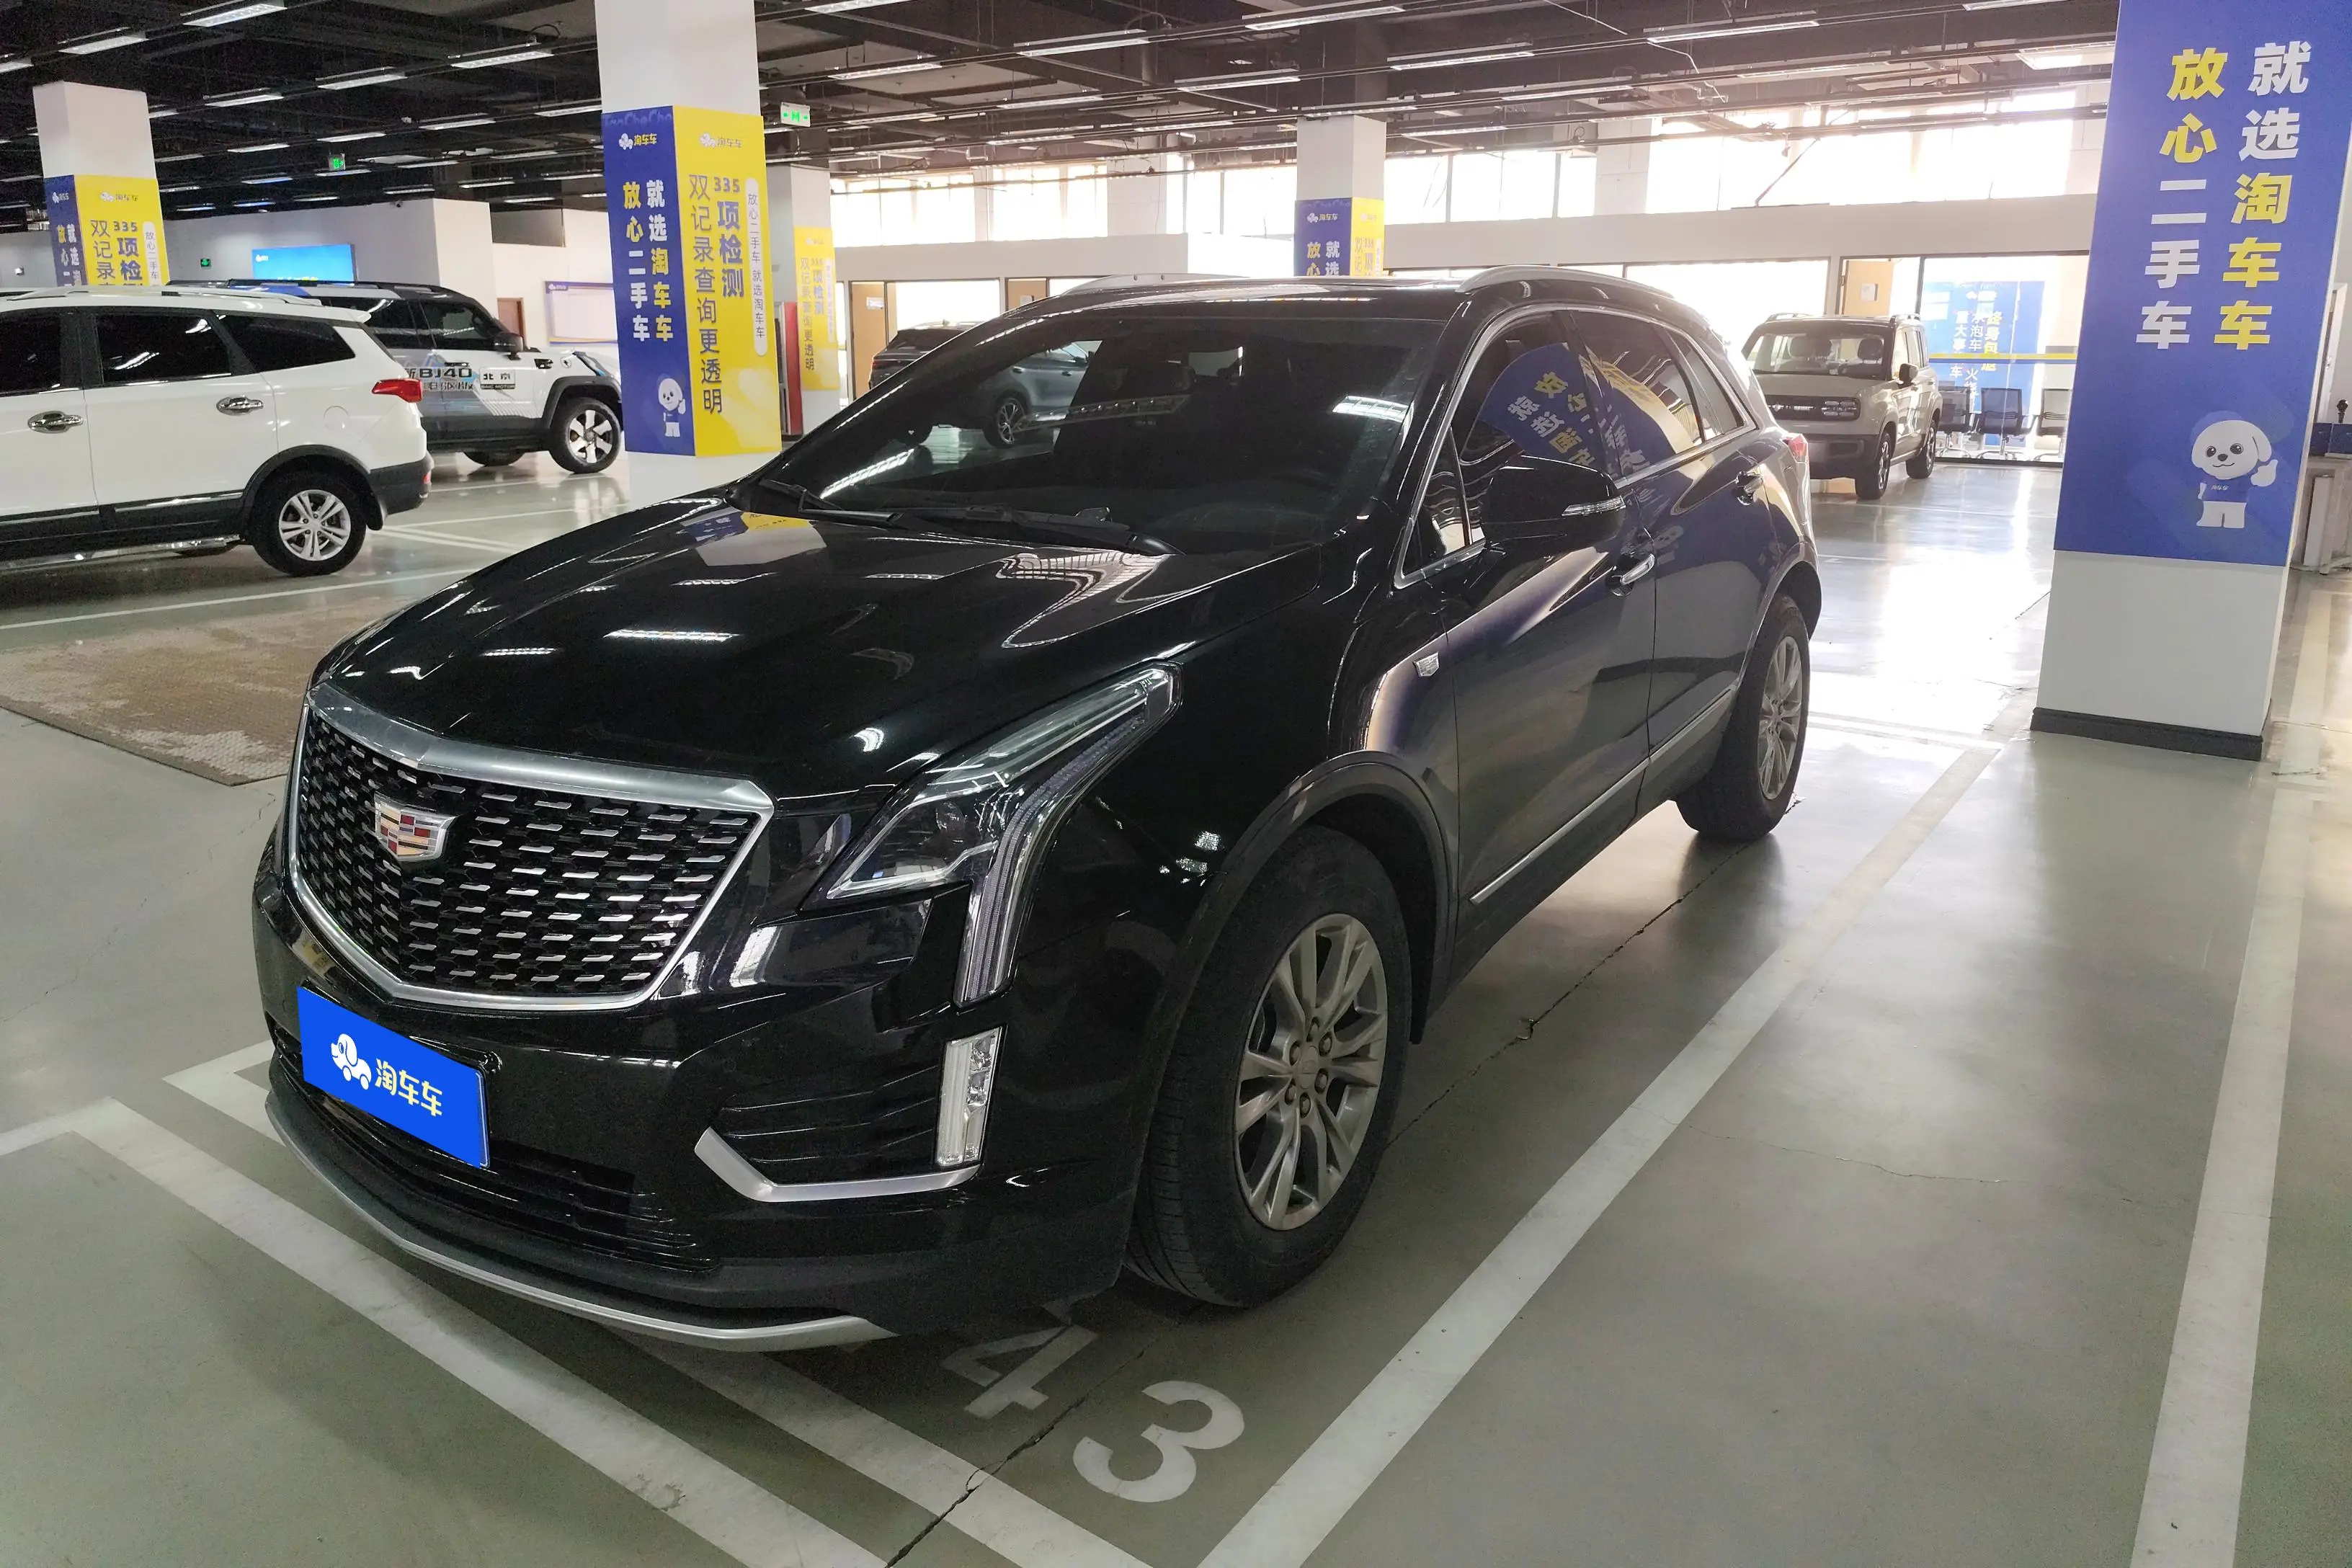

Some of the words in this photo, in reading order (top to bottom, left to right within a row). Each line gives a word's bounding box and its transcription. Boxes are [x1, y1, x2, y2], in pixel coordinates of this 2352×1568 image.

[633, 133, 657, 146] 淘车车
[717, 137, 743, 148] 淘车车
[747, 192, 762, 264] 放心二手车
[2135, 47, 2228, 350] 放心二手车
[2213, 40, 2311, 351] 就选淘车车
[90, 219, 116, 286] 双记录
[623, 181, 651, 342] 放心二手车
[646, 178, 674, 342] 就选淘车车
[1324, 241, 1340, 276] 就选
[688, 173, 723, 414] 双记录查询更透明
[752, 268, 766, 339] 就选淘车车
